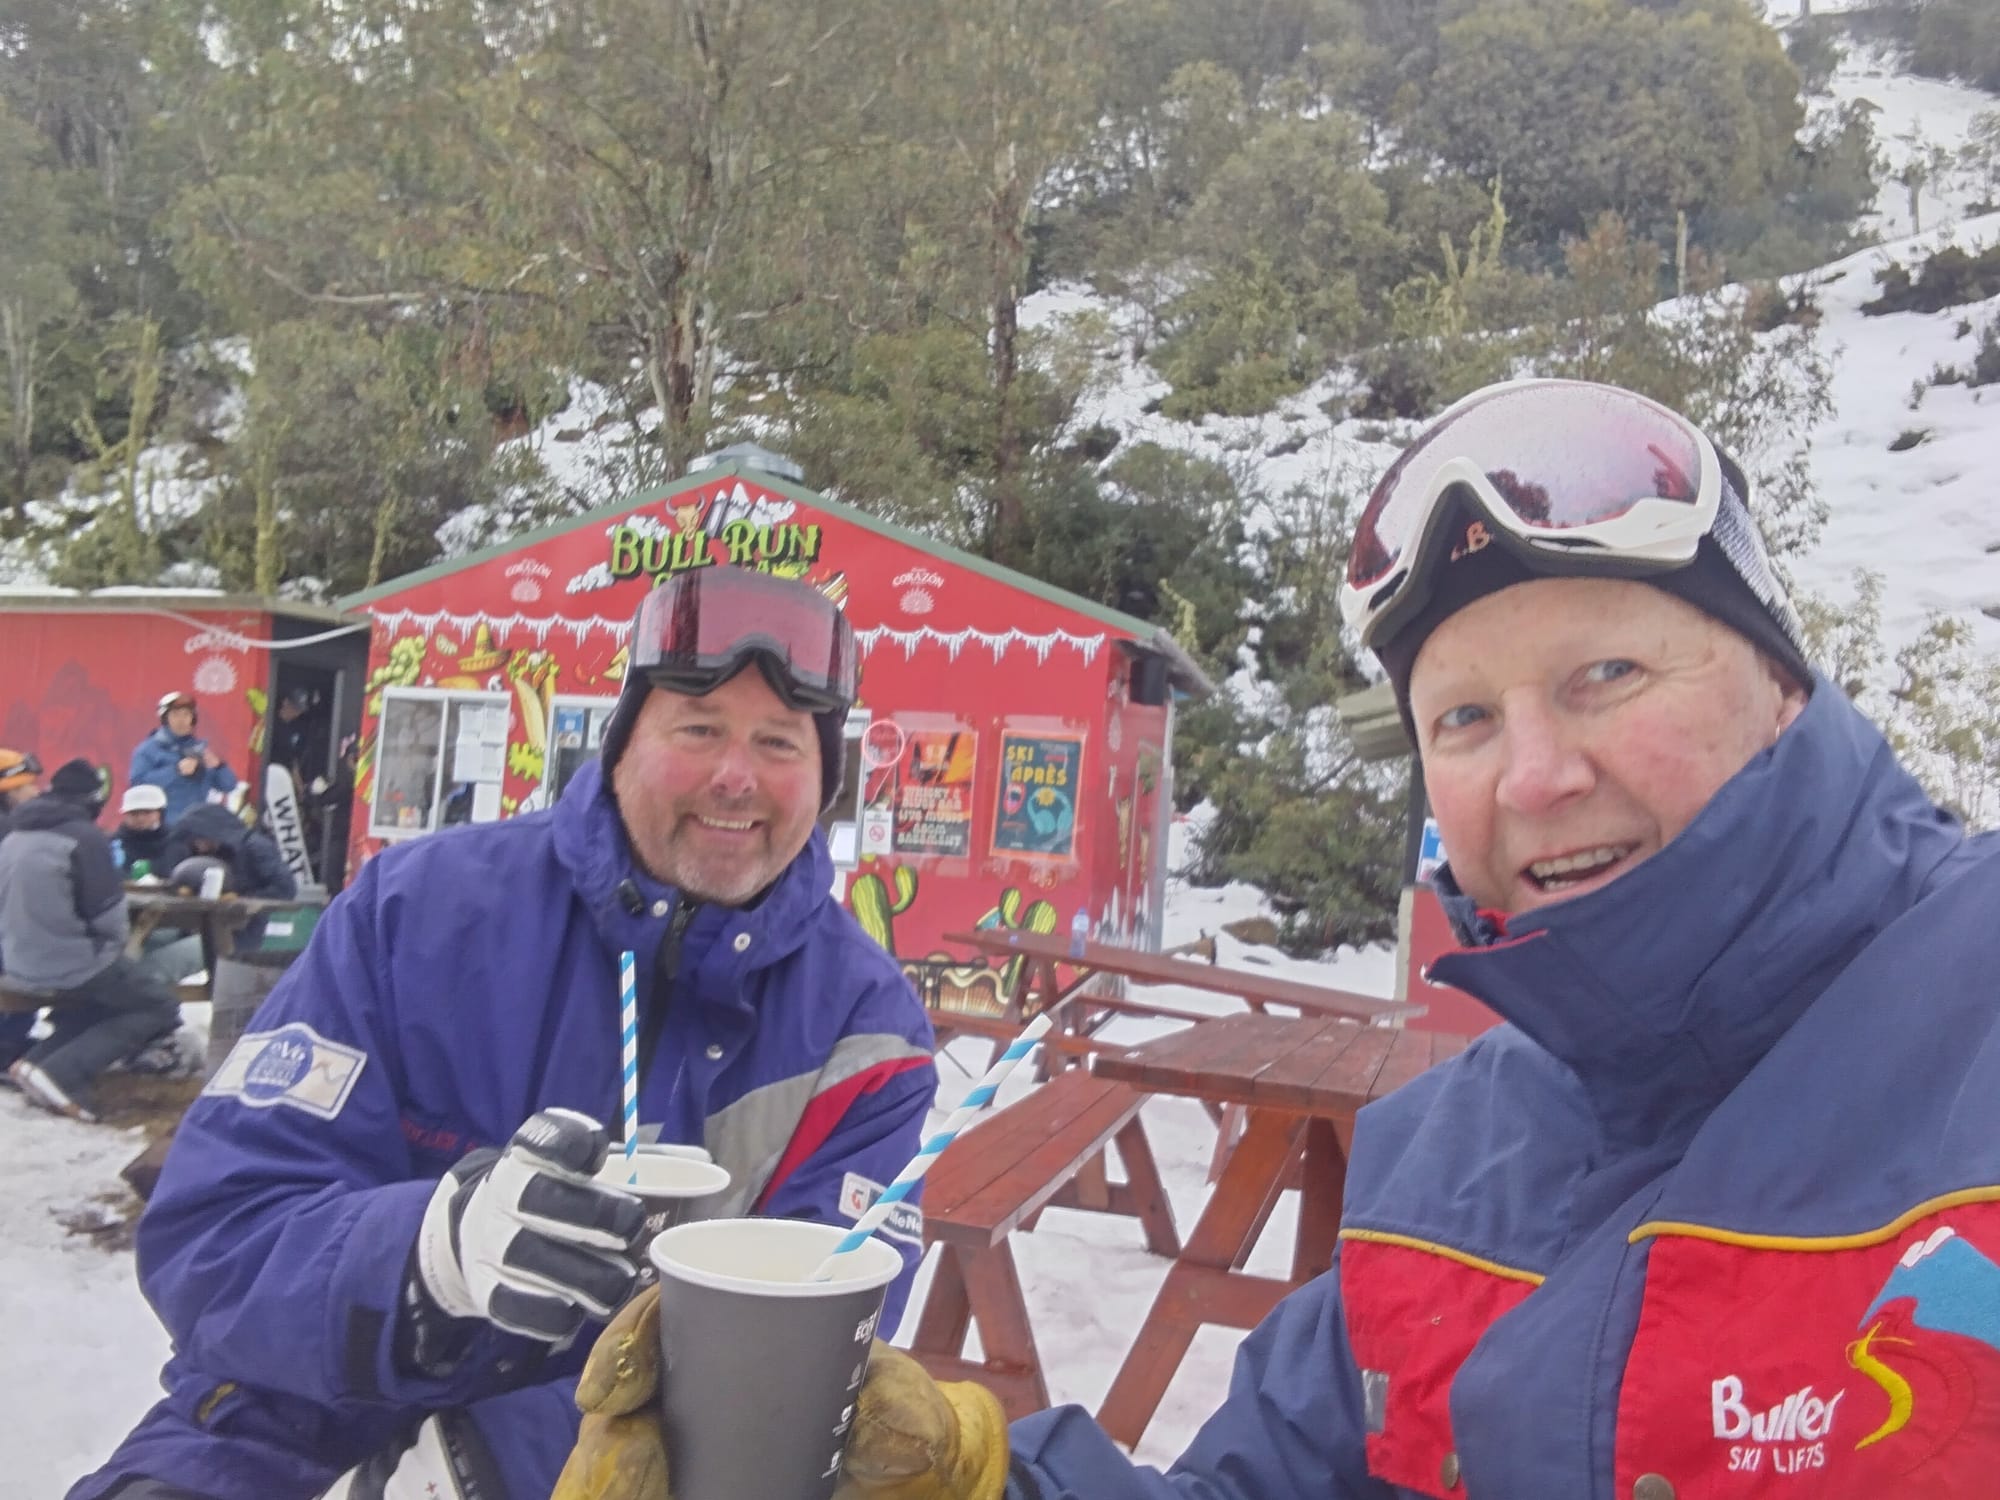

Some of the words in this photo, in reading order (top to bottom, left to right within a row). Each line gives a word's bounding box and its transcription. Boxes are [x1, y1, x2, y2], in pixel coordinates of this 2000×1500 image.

[610, 526, 713, 577] BULL
[720, 518, 820, 563] RUN
[1006, 745, 1034, 762] SKI
[1712, 1374, 1845, 1442] Buller
[1727, 1445, 1761, 1472] SKI
[1773, 1442, 1826, 1474] LIFTS
